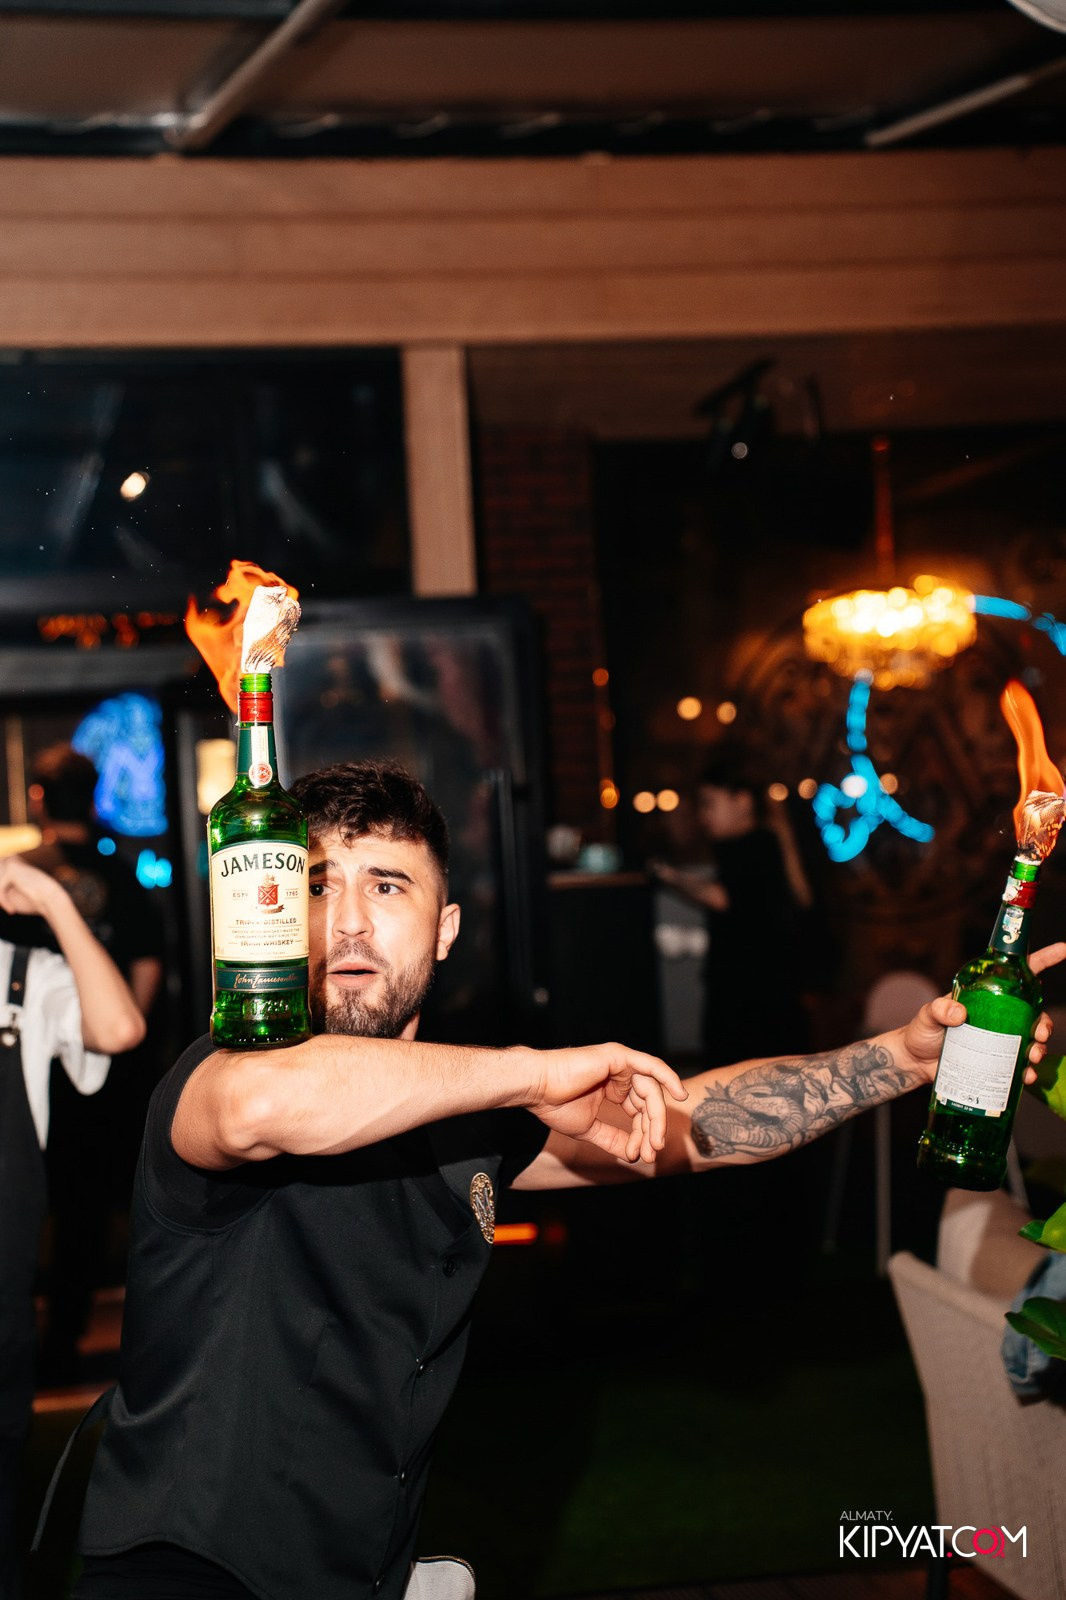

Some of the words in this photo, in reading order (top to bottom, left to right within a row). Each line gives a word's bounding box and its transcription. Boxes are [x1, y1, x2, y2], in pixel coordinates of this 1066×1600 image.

[221, 853, 305, 877] JAMESON
[263, 917, 297, 925] DISTILLED
[263, 939, 294, 947] WHISKEY
